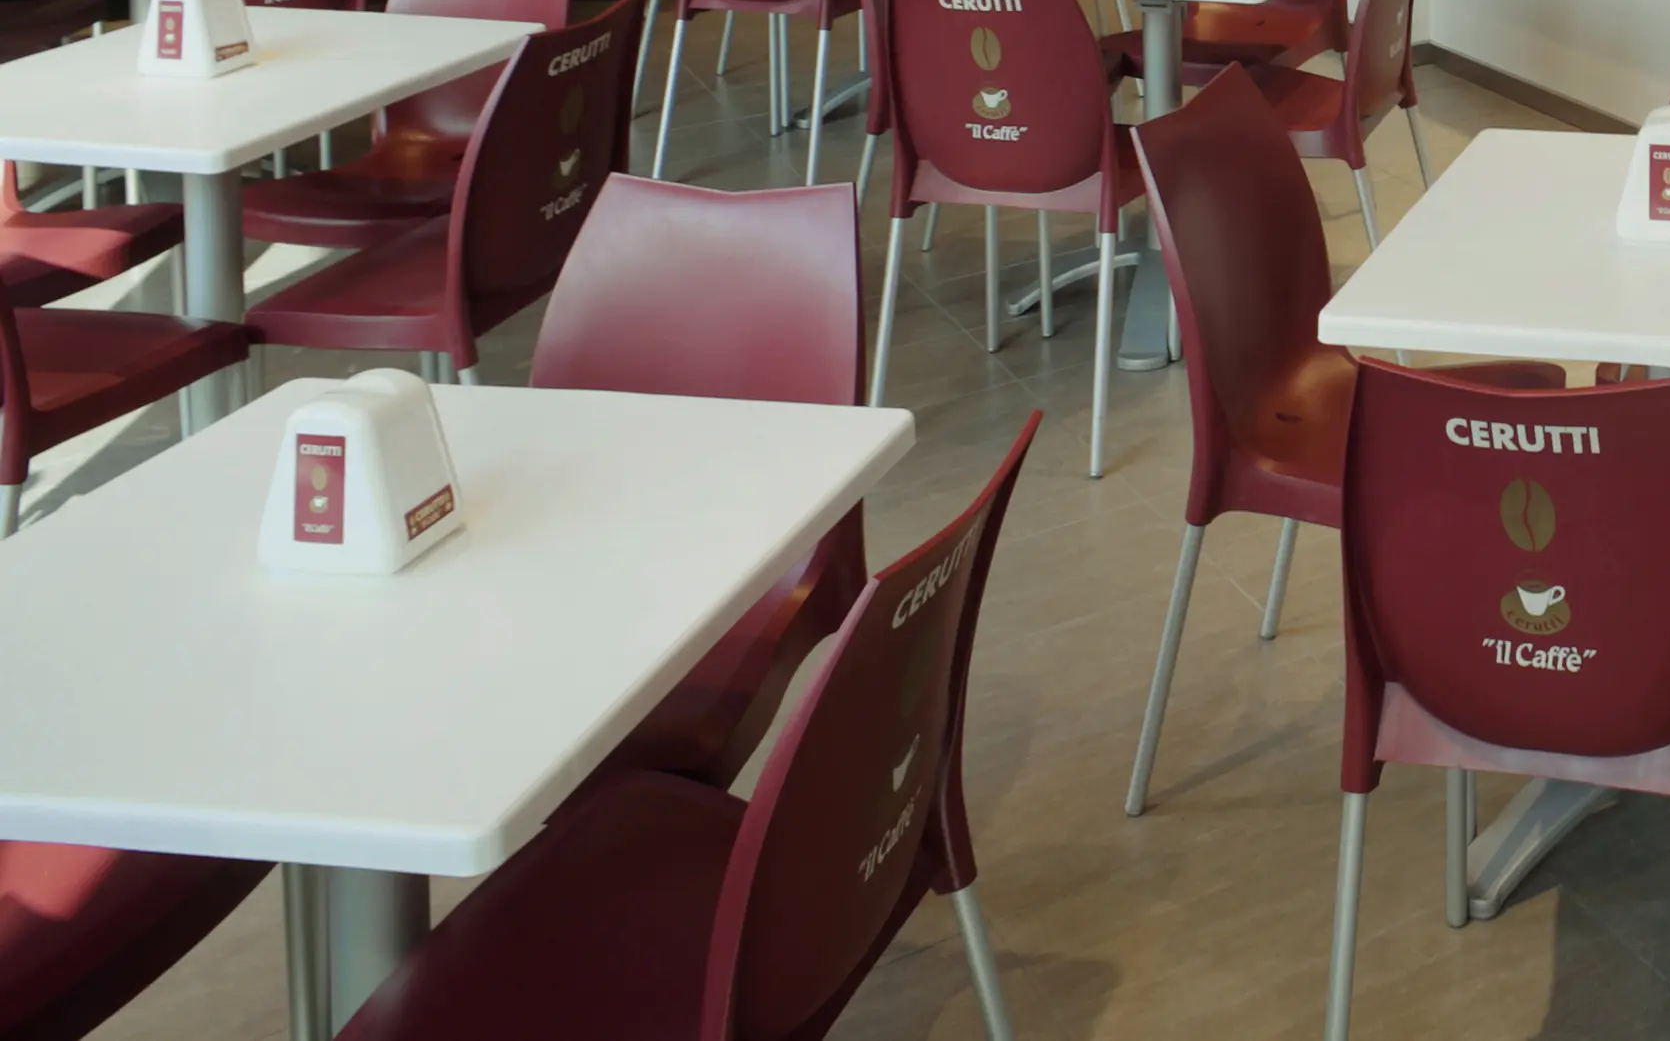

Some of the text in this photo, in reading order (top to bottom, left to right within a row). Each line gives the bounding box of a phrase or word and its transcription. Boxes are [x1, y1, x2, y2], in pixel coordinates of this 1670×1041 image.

[548, 30, 611, 77] CERUTTI
[300, 443, 342, 457] CERUTTI
[1445, 417, 1601, 455] CERUTTI
[1506, 610, 1565, 632] cerutti
[1482, 637, 1598, 673] "il Caffè"
